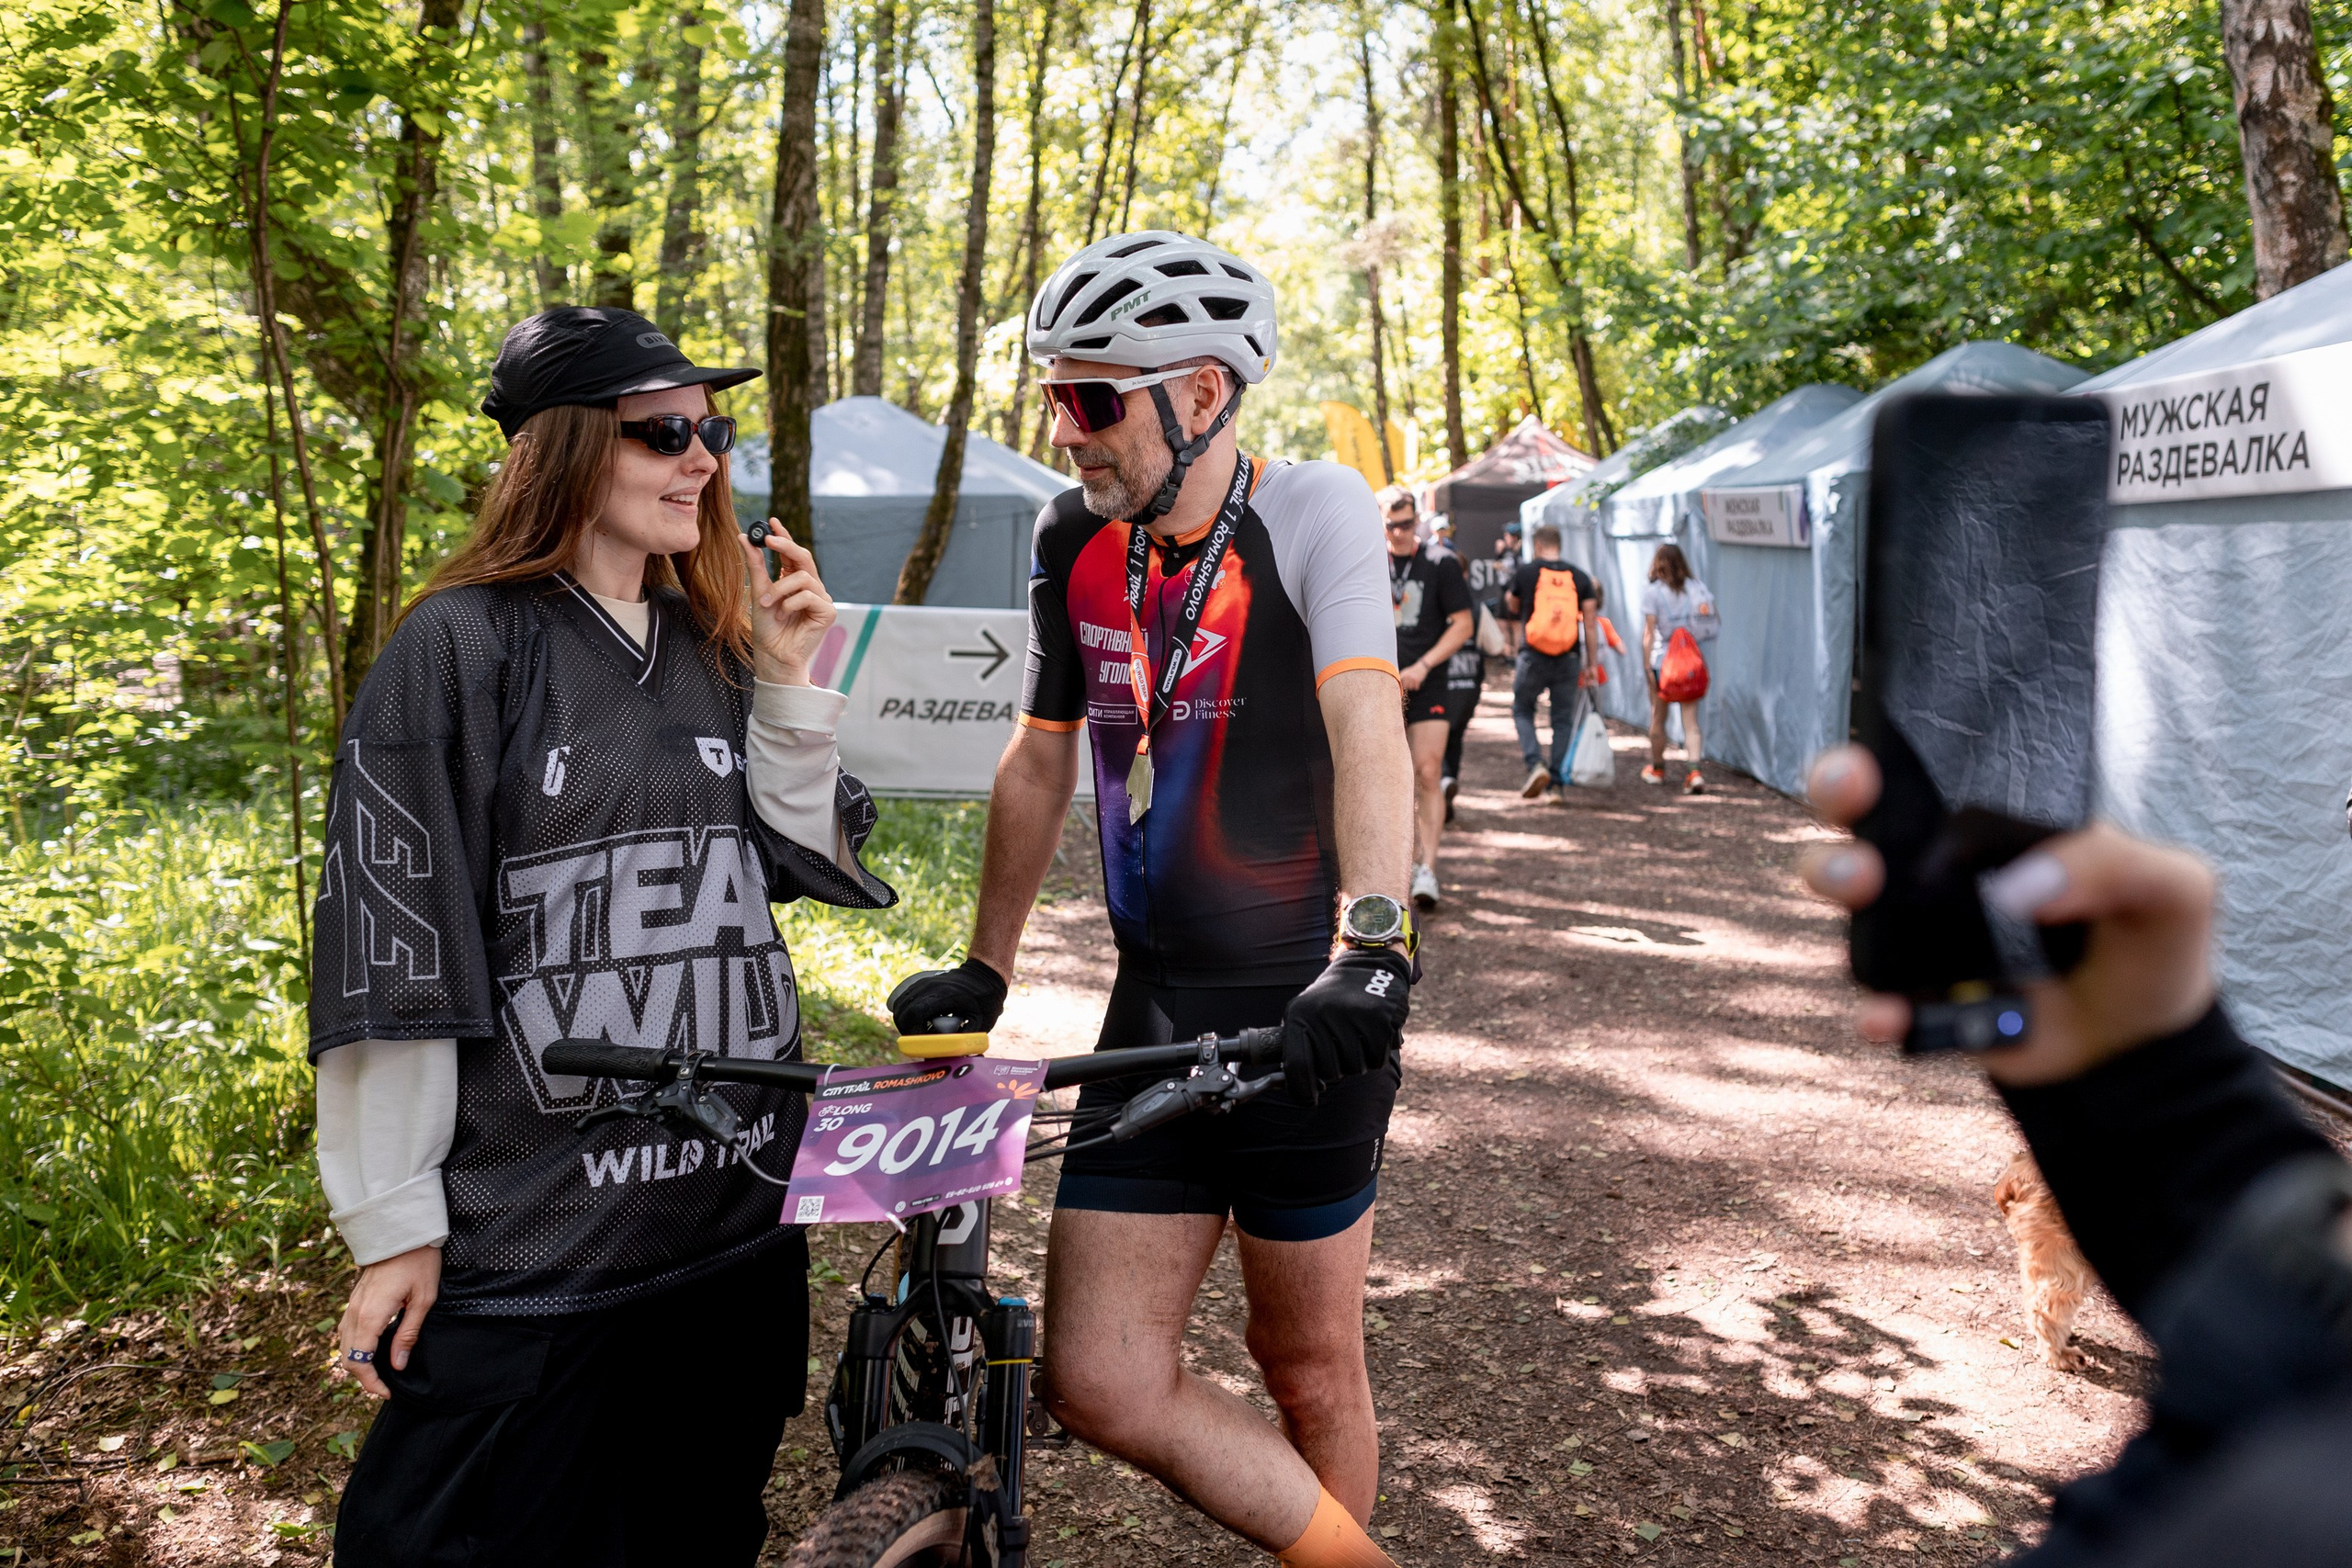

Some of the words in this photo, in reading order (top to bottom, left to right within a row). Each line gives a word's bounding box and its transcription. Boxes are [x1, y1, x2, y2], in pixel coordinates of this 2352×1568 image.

[1110, 289, 1151, 321] PMT
[2120, 381, 2270, 441] МУЖСКАЯ
[2117, 430, 2311, 489] РАЗДЕВАЛКА
[1185, 520, 1230, 621] ROMASHKOVO
[1080, 621, 1149, 654] СПОРТИВНЙ
[879, 698, 1012, 724] РАЗДЕВА
[1194, 697, 1247, 709] Discover
[1194, 709, 1236, 720] Fitness
[822, 1080, 872, 1098] CITYTRAIL
[873, 1069, 946, 1091] ROMASHKOVO
[958, 1066, 969, 1077] 1
[813, 1116, 845, 1133] 30
[833, 1102, 874, 1117] LONG
[822, 1098, 1011, 1177] 9014
[582, 1139, 705, 1189] WILD
